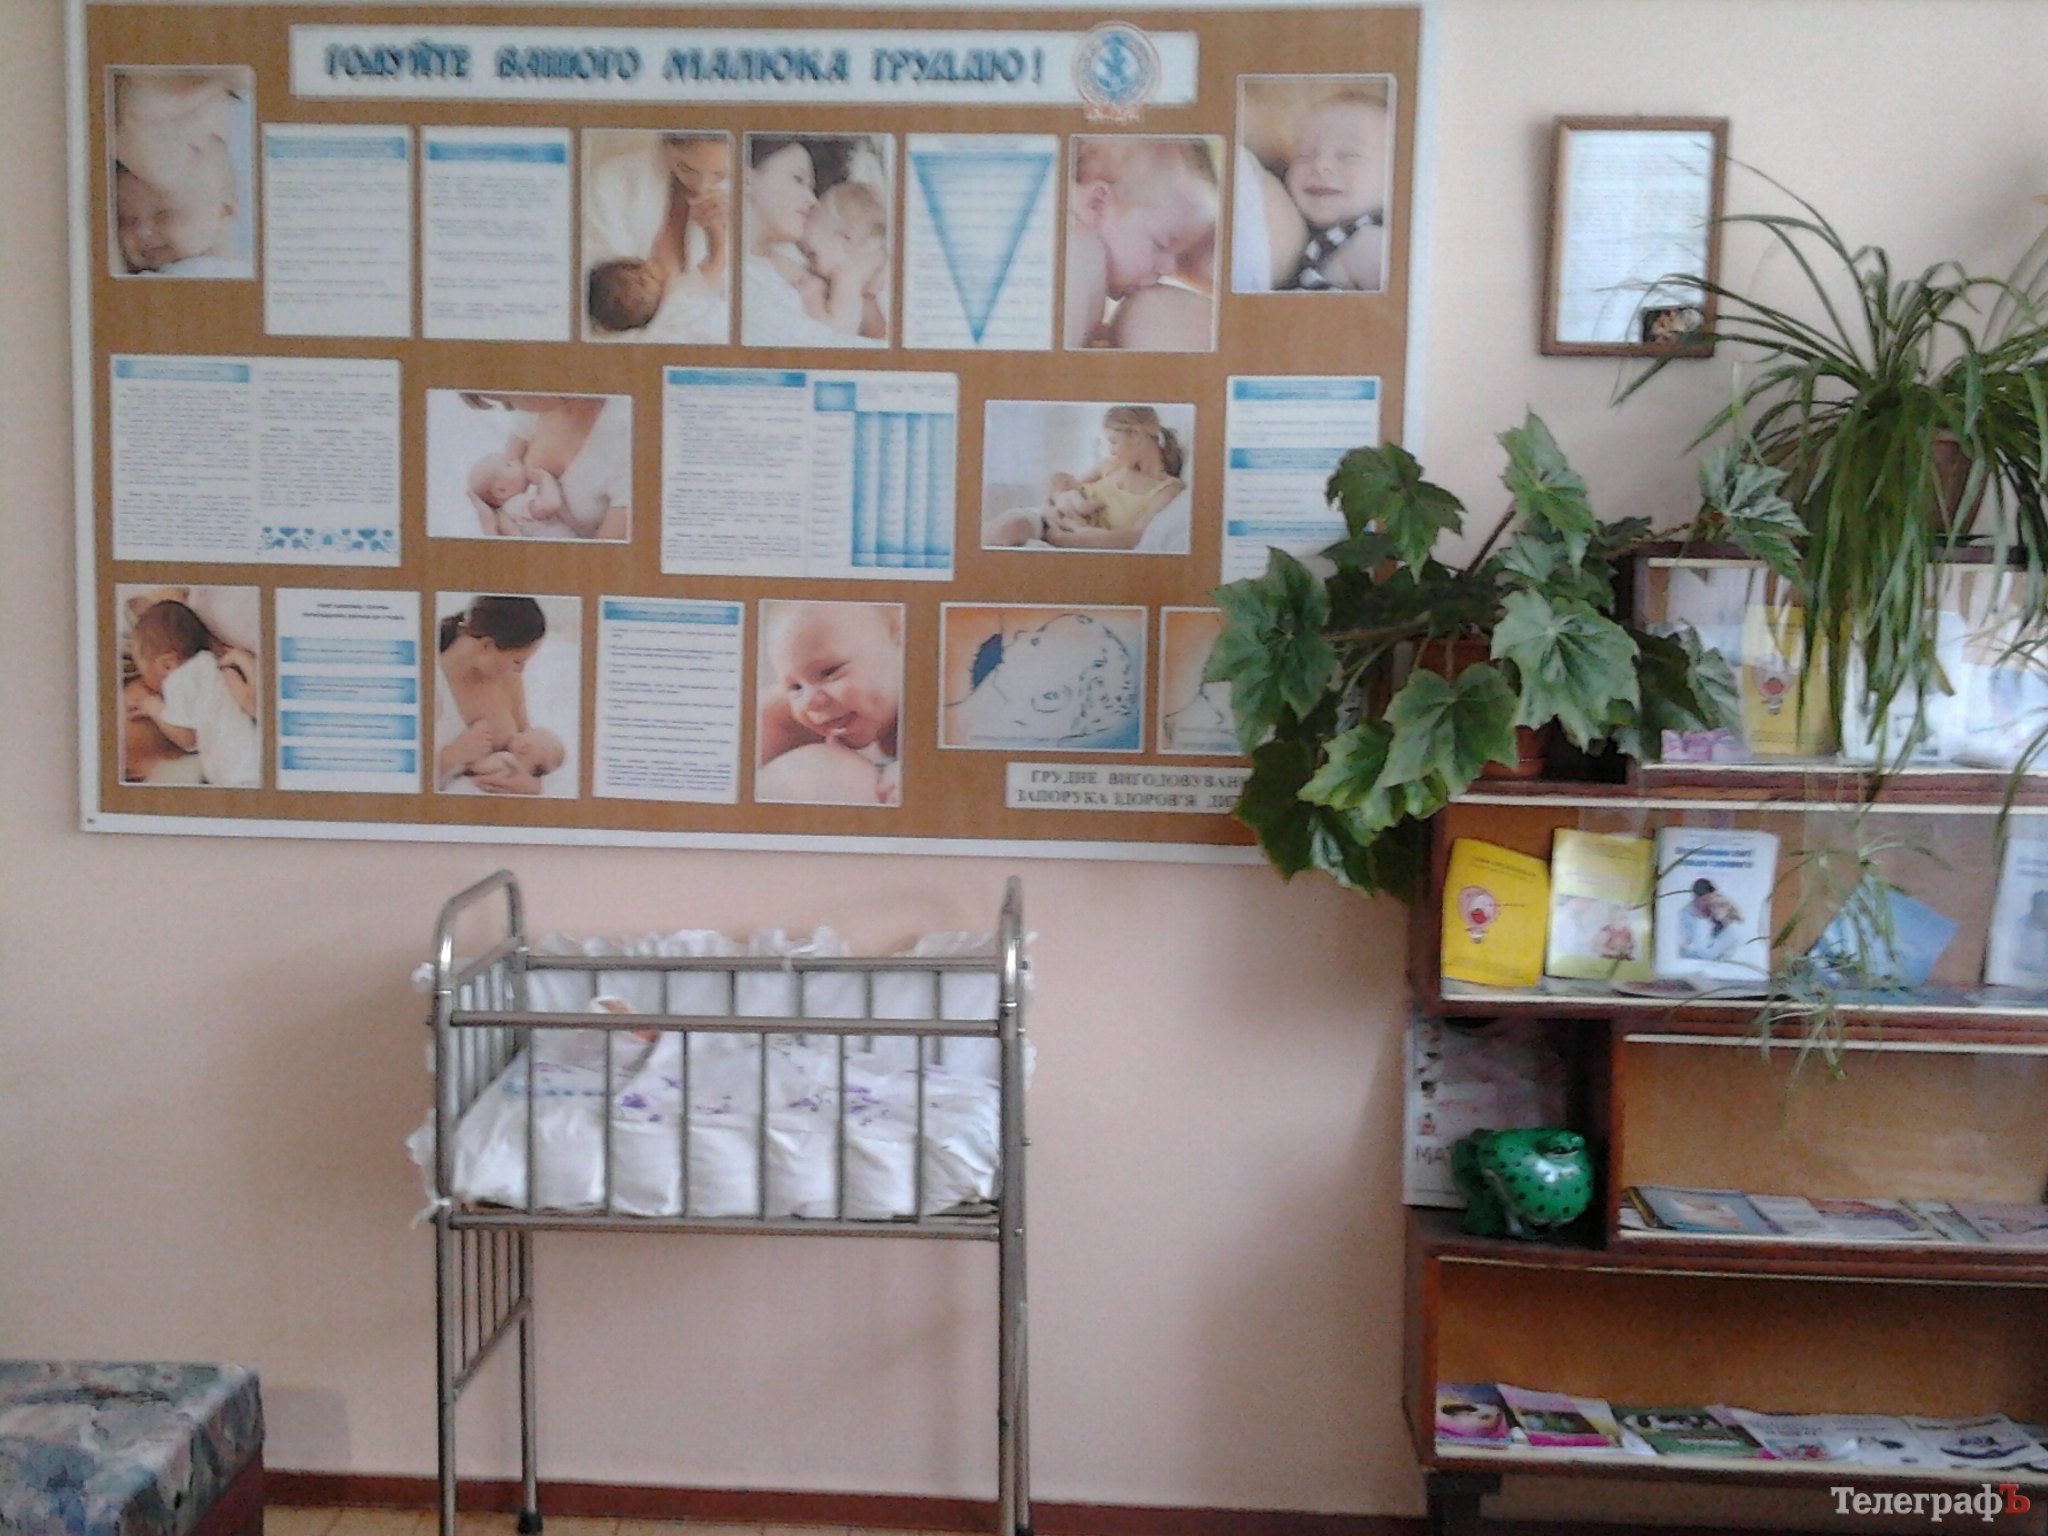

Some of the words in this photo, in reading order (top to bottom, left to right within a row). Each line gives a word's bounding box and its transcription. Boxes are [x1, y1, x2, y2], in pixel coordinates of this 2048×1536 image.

[325, 39, 471, 78] ГОДУЙТЕ
[494, 44, 643, 80] ВАШОГО
[661, 46, 848, 82] МАЛЮКА
[1031, 770, 1097, 784] ГРУДНЕ
